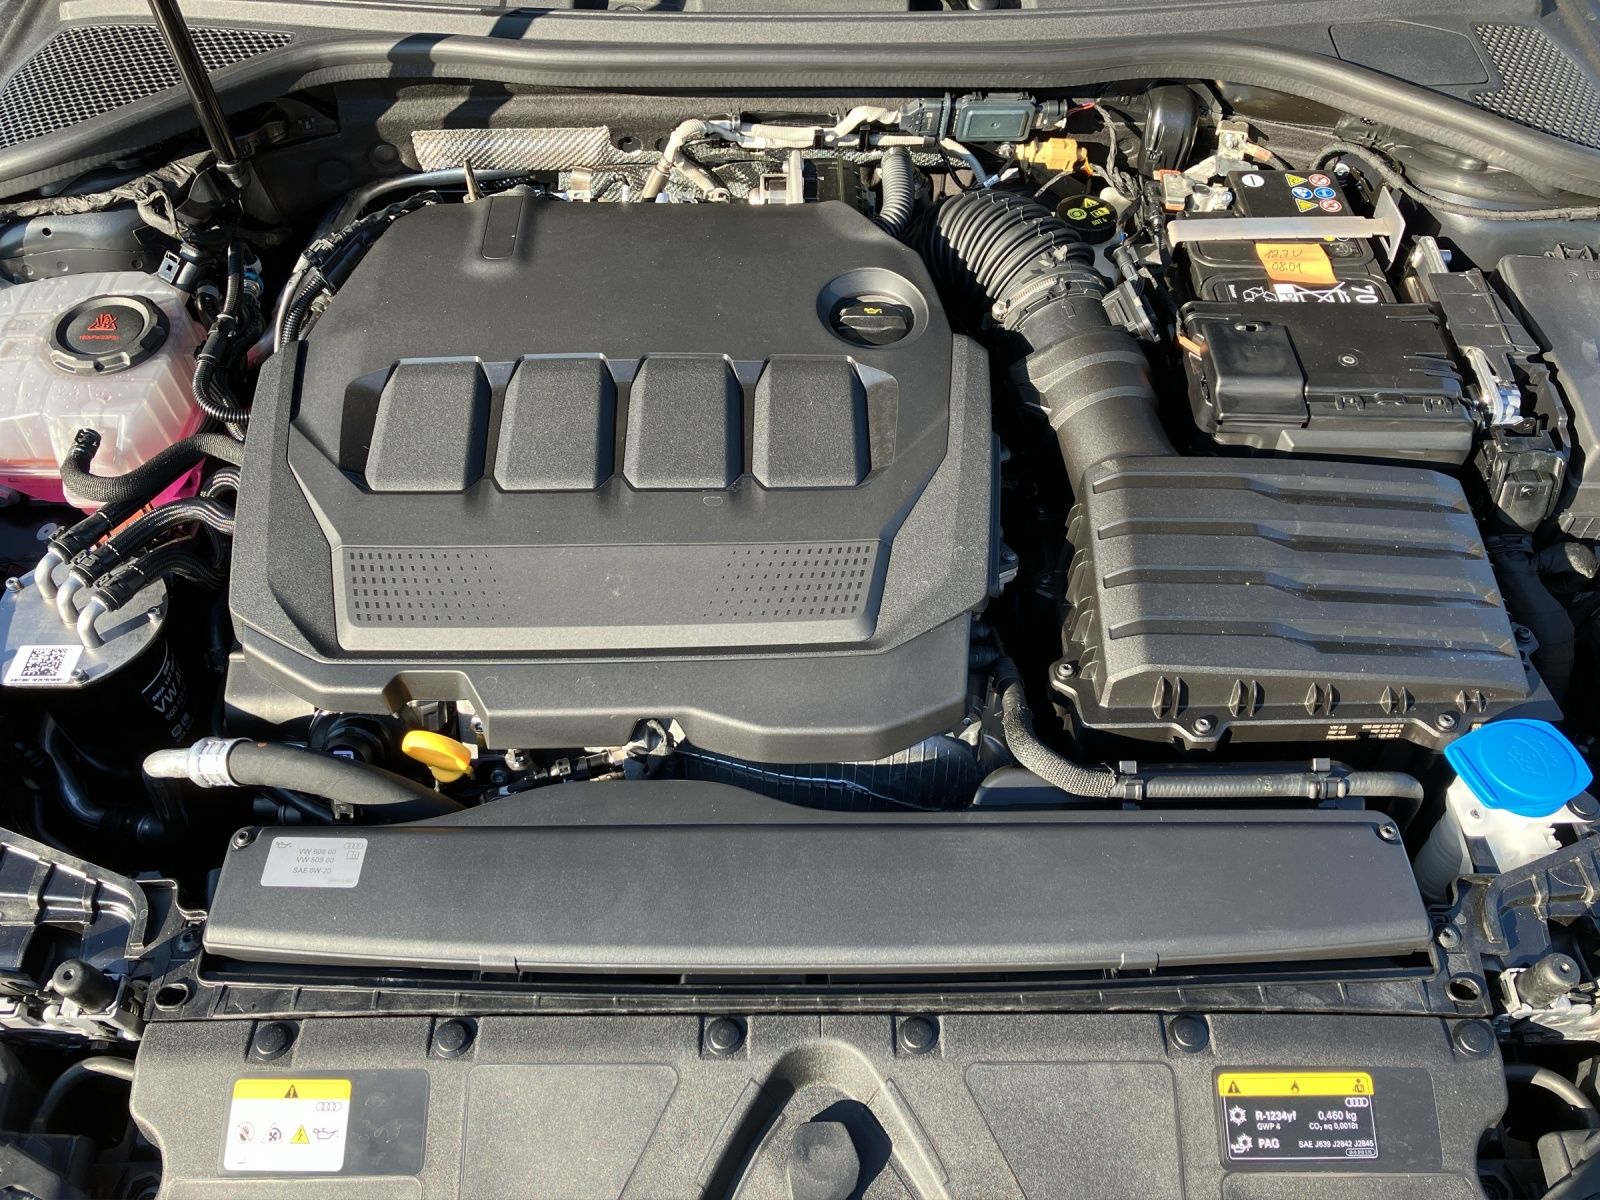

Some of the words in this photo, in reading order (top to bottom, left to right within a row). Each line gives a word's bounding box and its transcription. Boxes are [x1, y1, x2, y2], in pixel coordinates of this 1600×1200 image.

[1255, 1110, 1297, 1123] R-1234yf
[1317, 1110, 1344, 1121] 0,460
[1345, 1110, 1358, 1122] kg
[1258, 1138, 1280, 1149] PAG
[1298, 1140, 1313, 1148] SAE
[1315, 1140, 1331, 1148] J639
[1332, 1140, 1352, 1148] J2842
[1353, 1139, 1375, 1147] J2845
